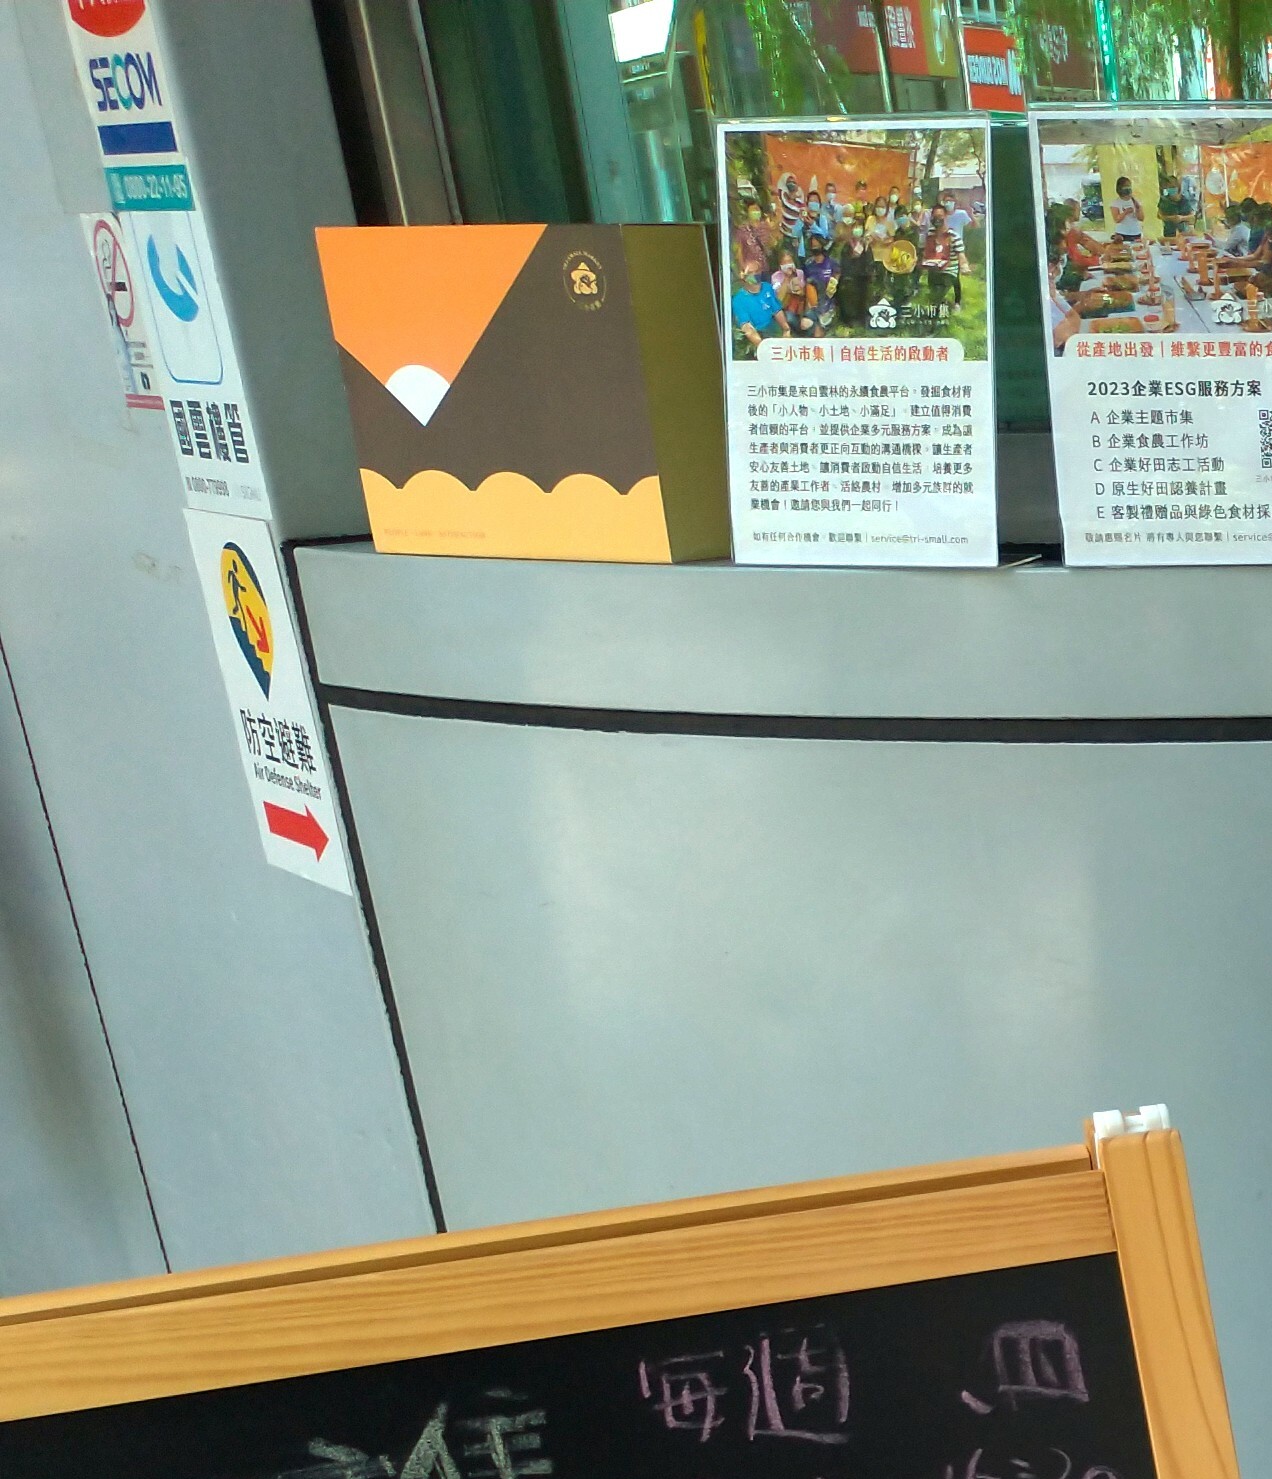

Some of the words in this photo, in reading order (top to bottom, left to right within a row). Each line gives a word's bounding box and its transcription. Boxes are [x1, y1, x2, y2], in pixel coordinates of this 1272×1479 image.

[88, 51, 162, 111] SECOM
[1087, 379, 1263, 398] 2023企業ESG服務方案
[1090, 411, 1100, 425] A
[1106, 409, 1194, 425] 企業主題市集
[1092, 434, 1101, 448] B
[1107, 432, 1209, 449] 企業食農工作坊
[1093, 458, 1102, 472] C
[1109, 456, 1225, 472] 企業好田志工活動
[1095, 482, 1105, 496] D
[1096, 505, 1105, 519] E
[240, 708, 318, 776] 防空避難
